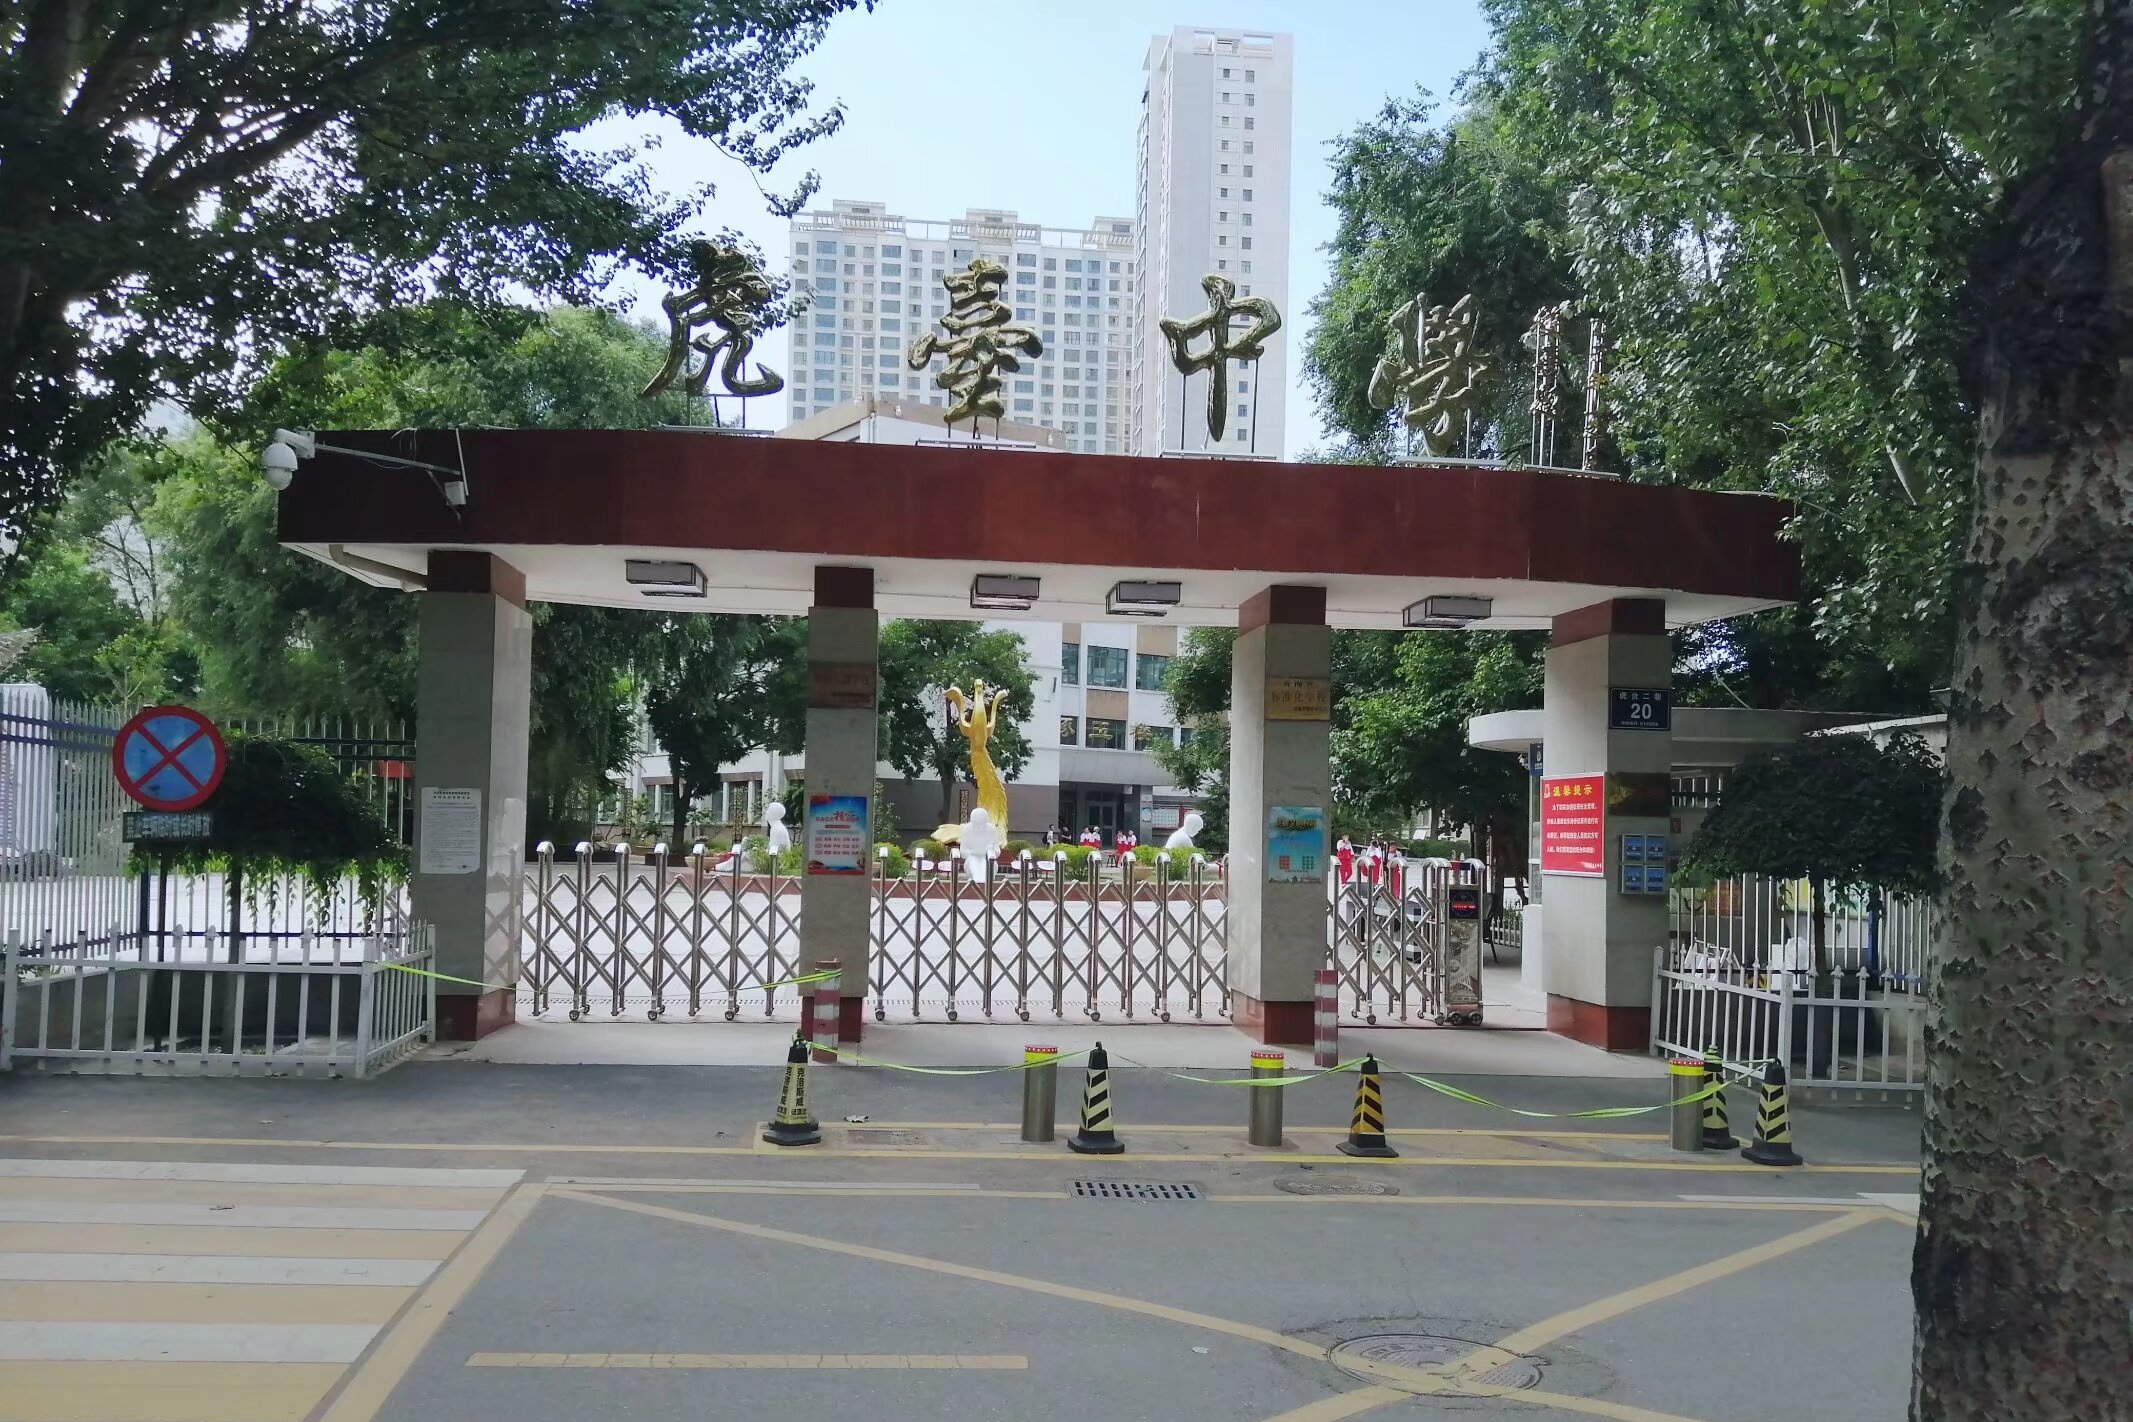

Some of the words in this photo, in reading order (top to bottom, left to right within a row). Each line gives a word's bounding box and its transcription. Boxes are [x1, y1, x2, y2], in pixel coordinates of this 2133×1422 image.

[1630, 703, 1652, 719] 20
[1552, 784, 1593, 797] 温馨提示
